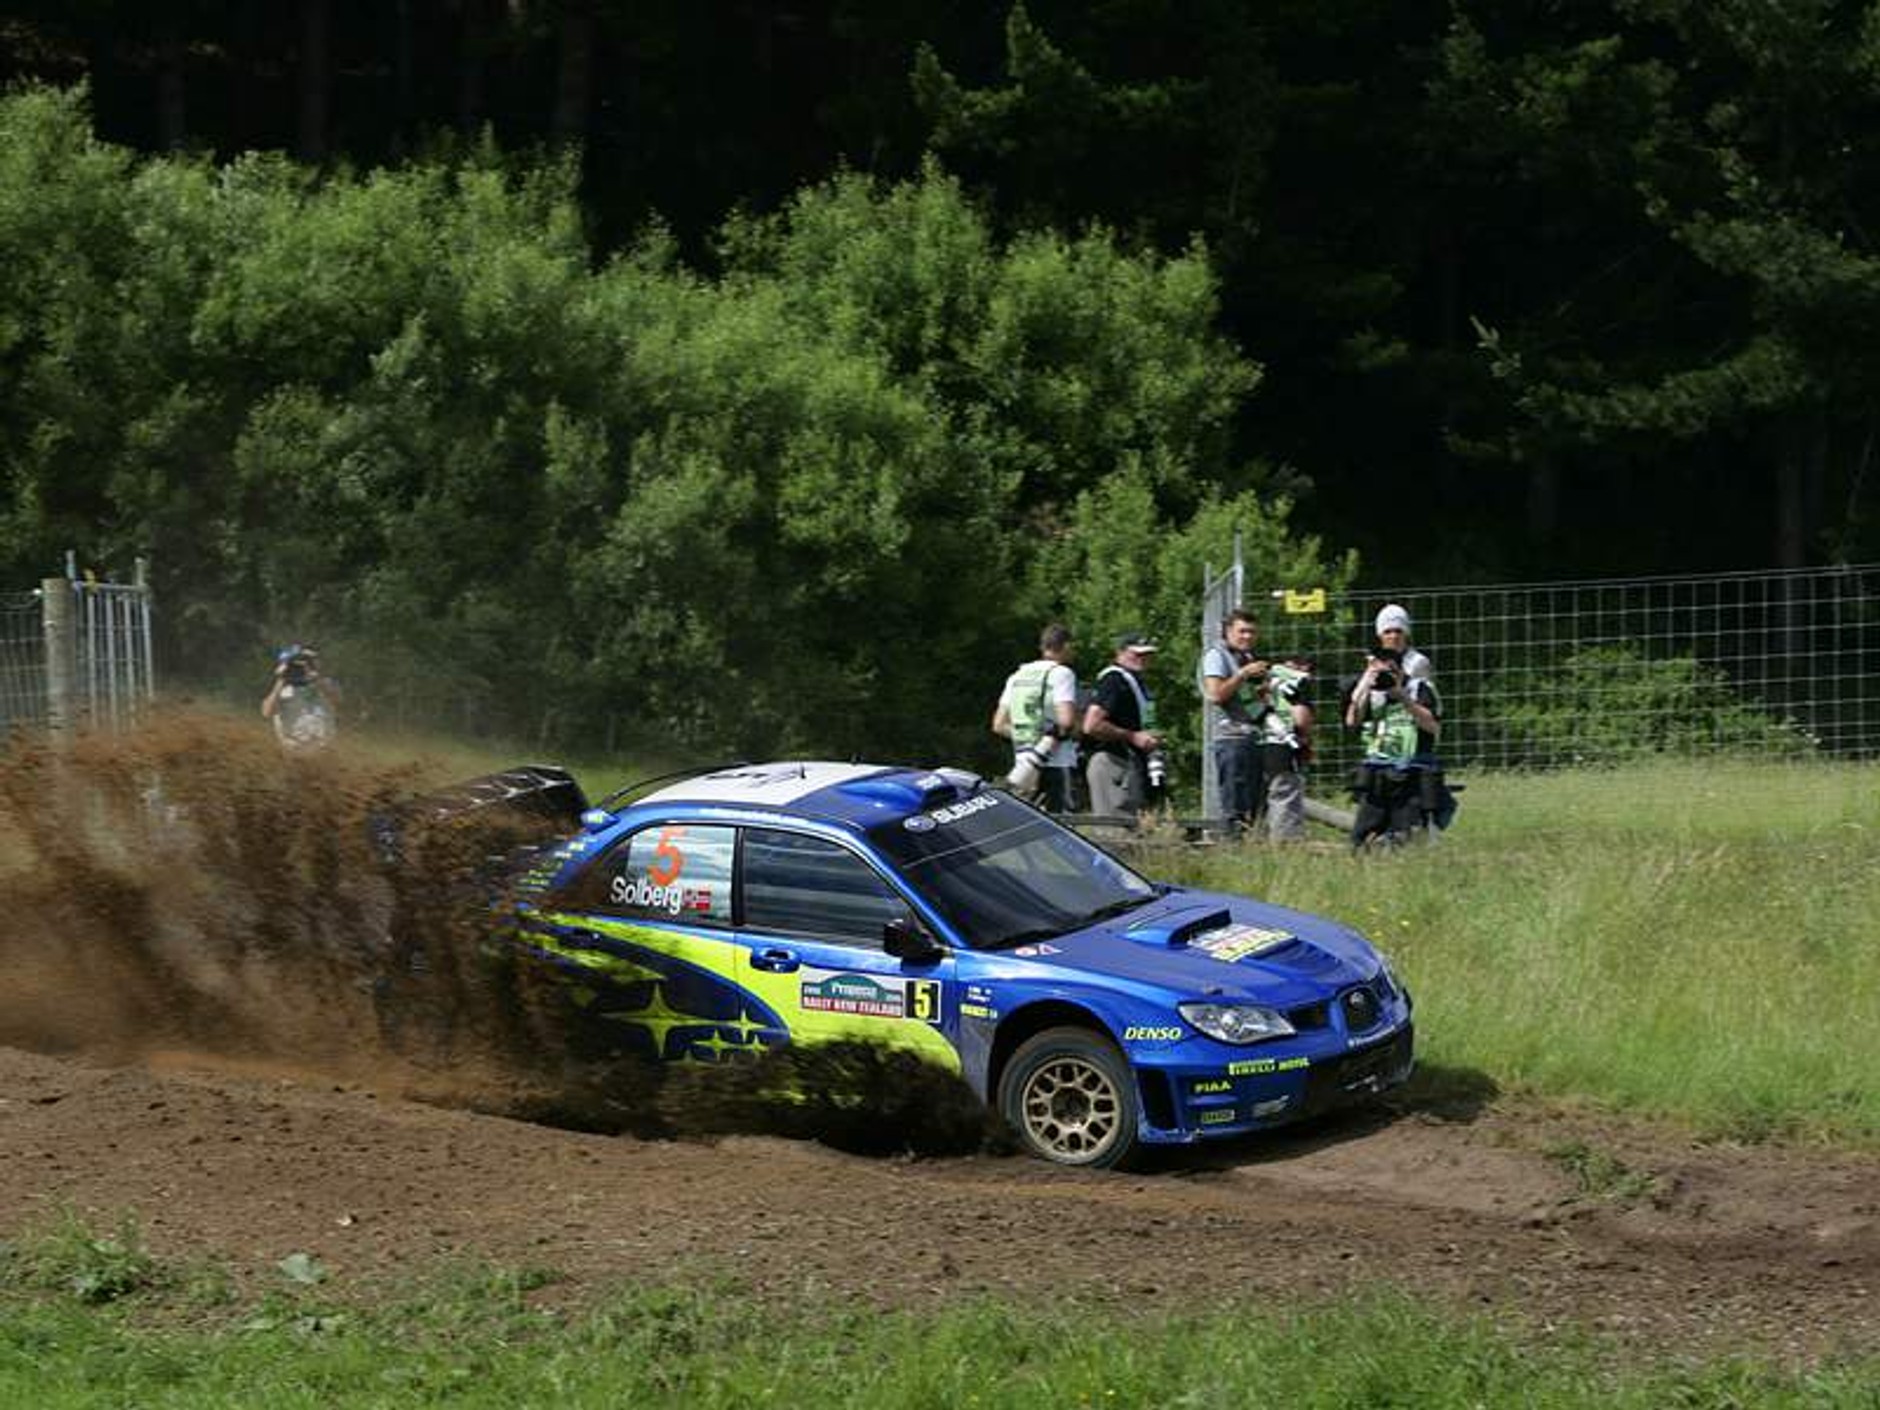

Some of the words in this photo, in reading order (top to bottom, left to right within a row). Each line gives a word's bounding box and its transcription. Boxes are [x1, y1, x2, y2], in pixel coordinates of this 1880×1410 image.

[931, 789, 998, 824] SUBARU
[646, 826, 685, 887] 5
[610, 876, 682, 915] Solberg
[914, 980, 932, 1019] 5
[1125, 1026, 1182, 1041] DENSO
